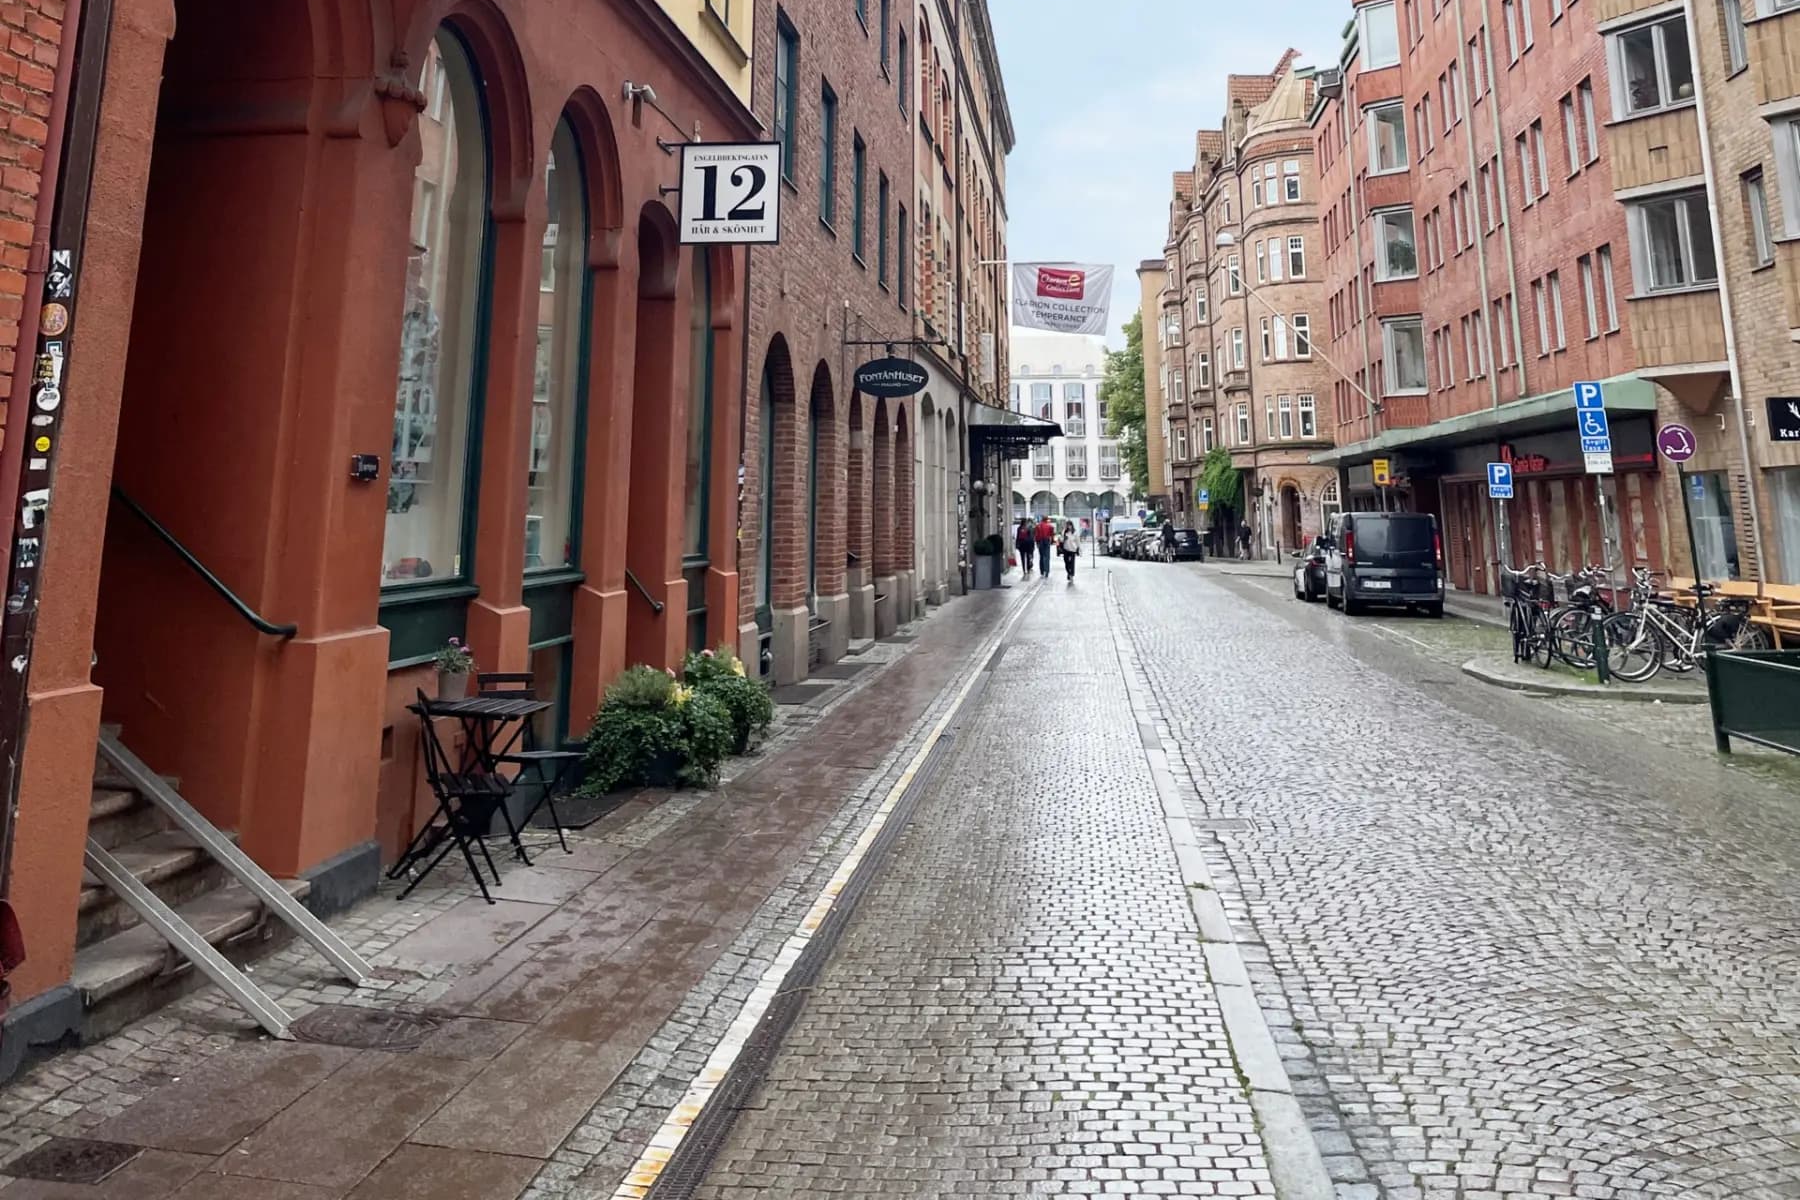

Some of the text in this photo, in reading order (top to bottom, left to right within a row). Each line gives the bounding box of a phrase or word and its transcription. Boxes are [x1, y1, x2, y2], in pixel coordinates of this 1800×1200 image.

[692, 165, 766, 221] 12
[691, 224, 765, 234] HÅR & SKÖNHET
[1052, 303, 1105, 314] COLLECTION
[1032, 310, 1088, 323] TEMPERANCE
[1580, 384, 1597, 406] P
[1779, 428, 1800, 438] Kar
[1493, 465, 1507, 484] P
